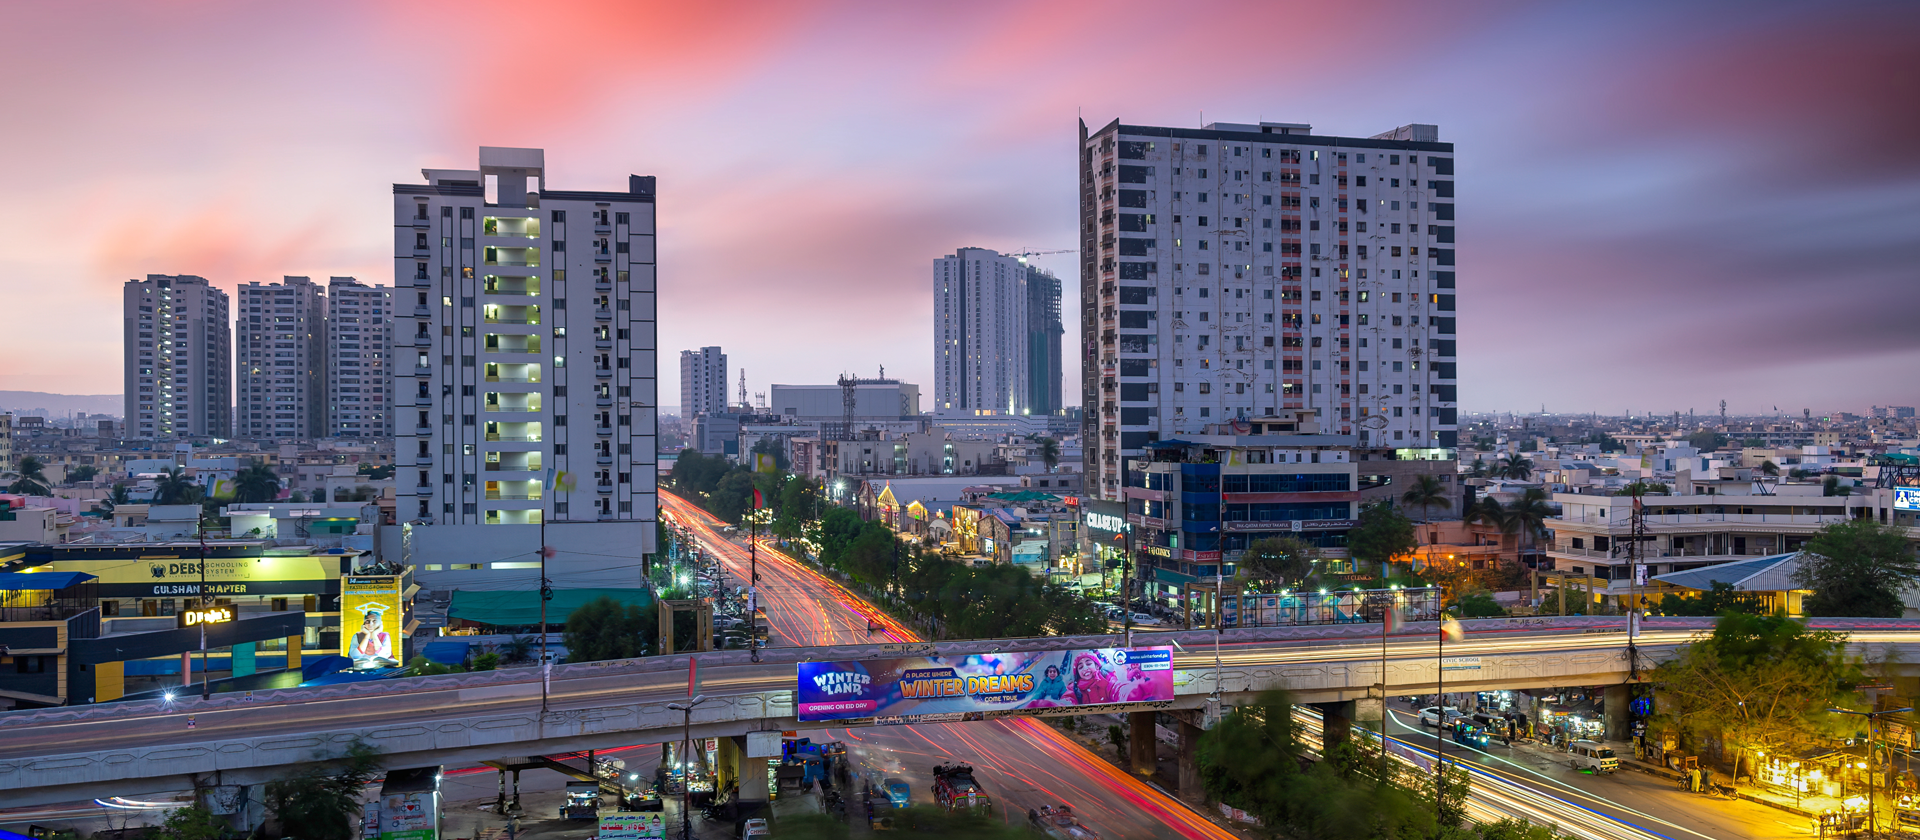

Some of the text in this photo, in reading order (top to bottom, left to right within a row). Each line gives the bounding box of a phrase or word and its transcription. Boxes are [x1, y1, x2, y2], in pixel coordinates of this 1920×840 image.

[1087, 512, 1111, 531] CHASE
[1111, 516, 1122, 533] UP
[1156, 547, 1170, 558] CLINICS
[169, 563, 203, 574] DEBS
[154, 584, 246, 594] GULSHAN CHAPTER
[813, 672, 870, 686] WINTER
[827, 683, 862, 695] LAND
[899, 675, 1033, 698] WINTER DREAMS
